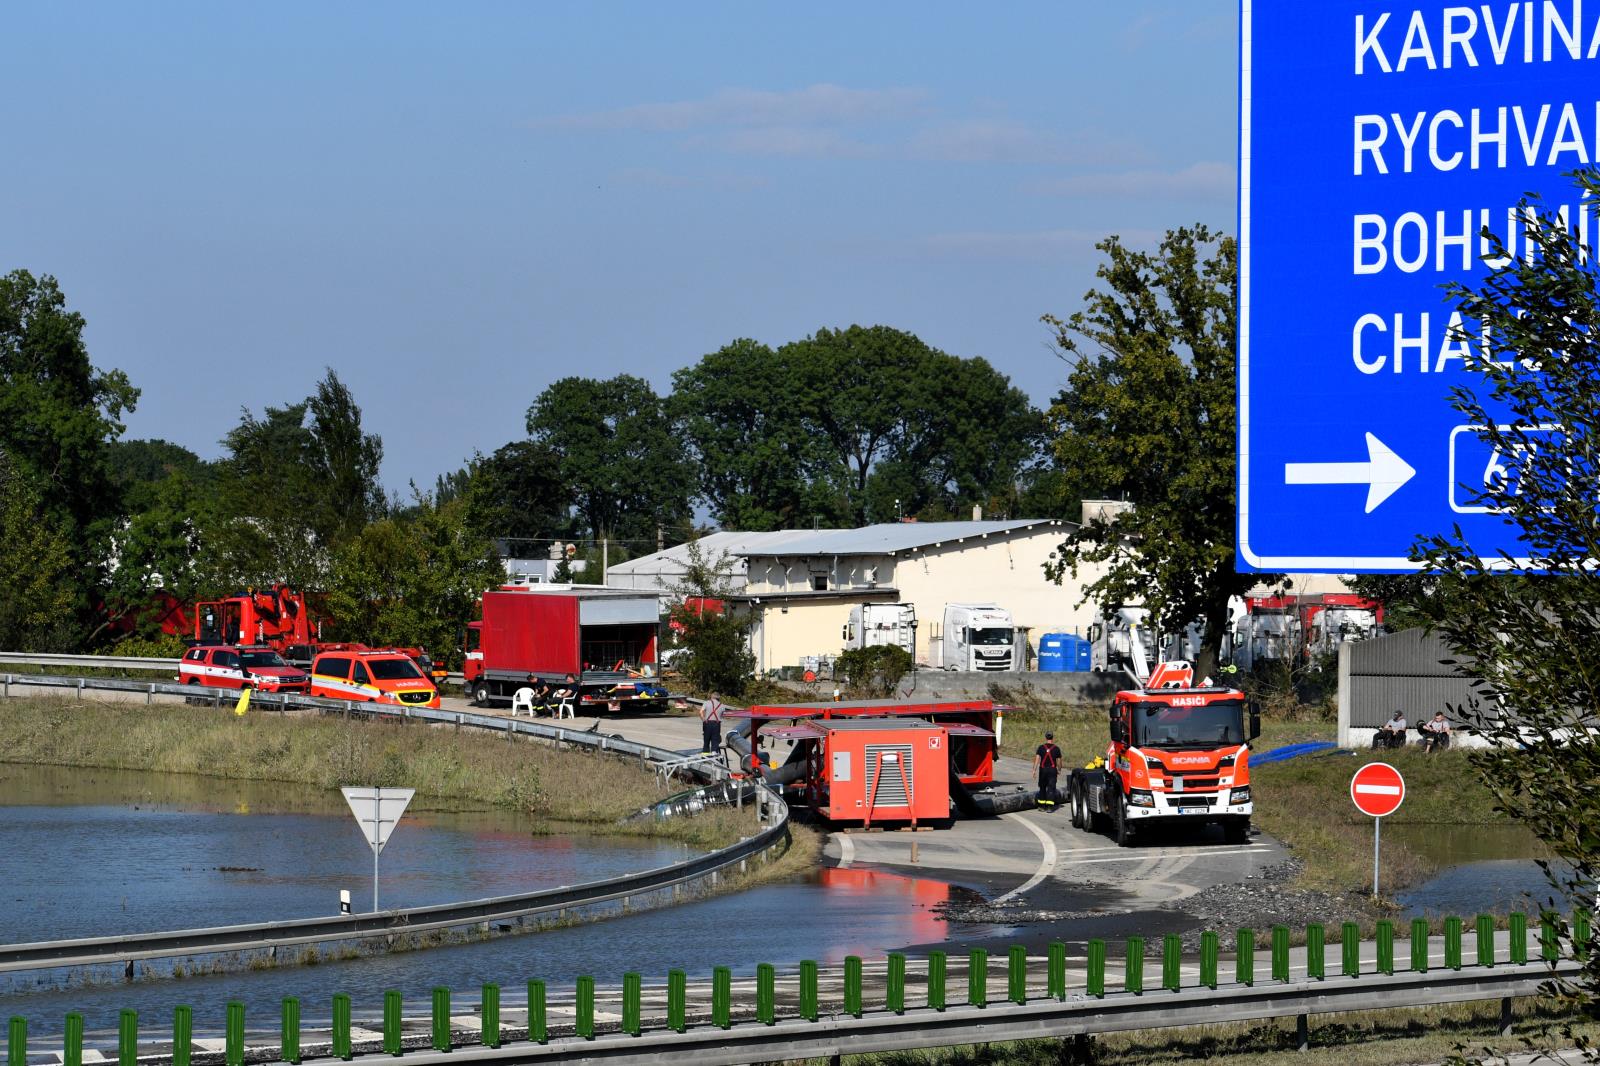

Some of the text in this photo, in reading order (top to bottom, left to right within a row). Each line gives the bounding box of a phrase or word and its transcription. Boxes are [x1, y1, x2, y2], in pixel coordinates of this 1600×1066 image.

[1354, 102, 1600, 176] RYCHVA
[1354, 188, 1600, 275] BOHUMÍ
[1172, 696, 1206, 706] HASIČI
[1171, 756, 1211, 764] SCANIA
